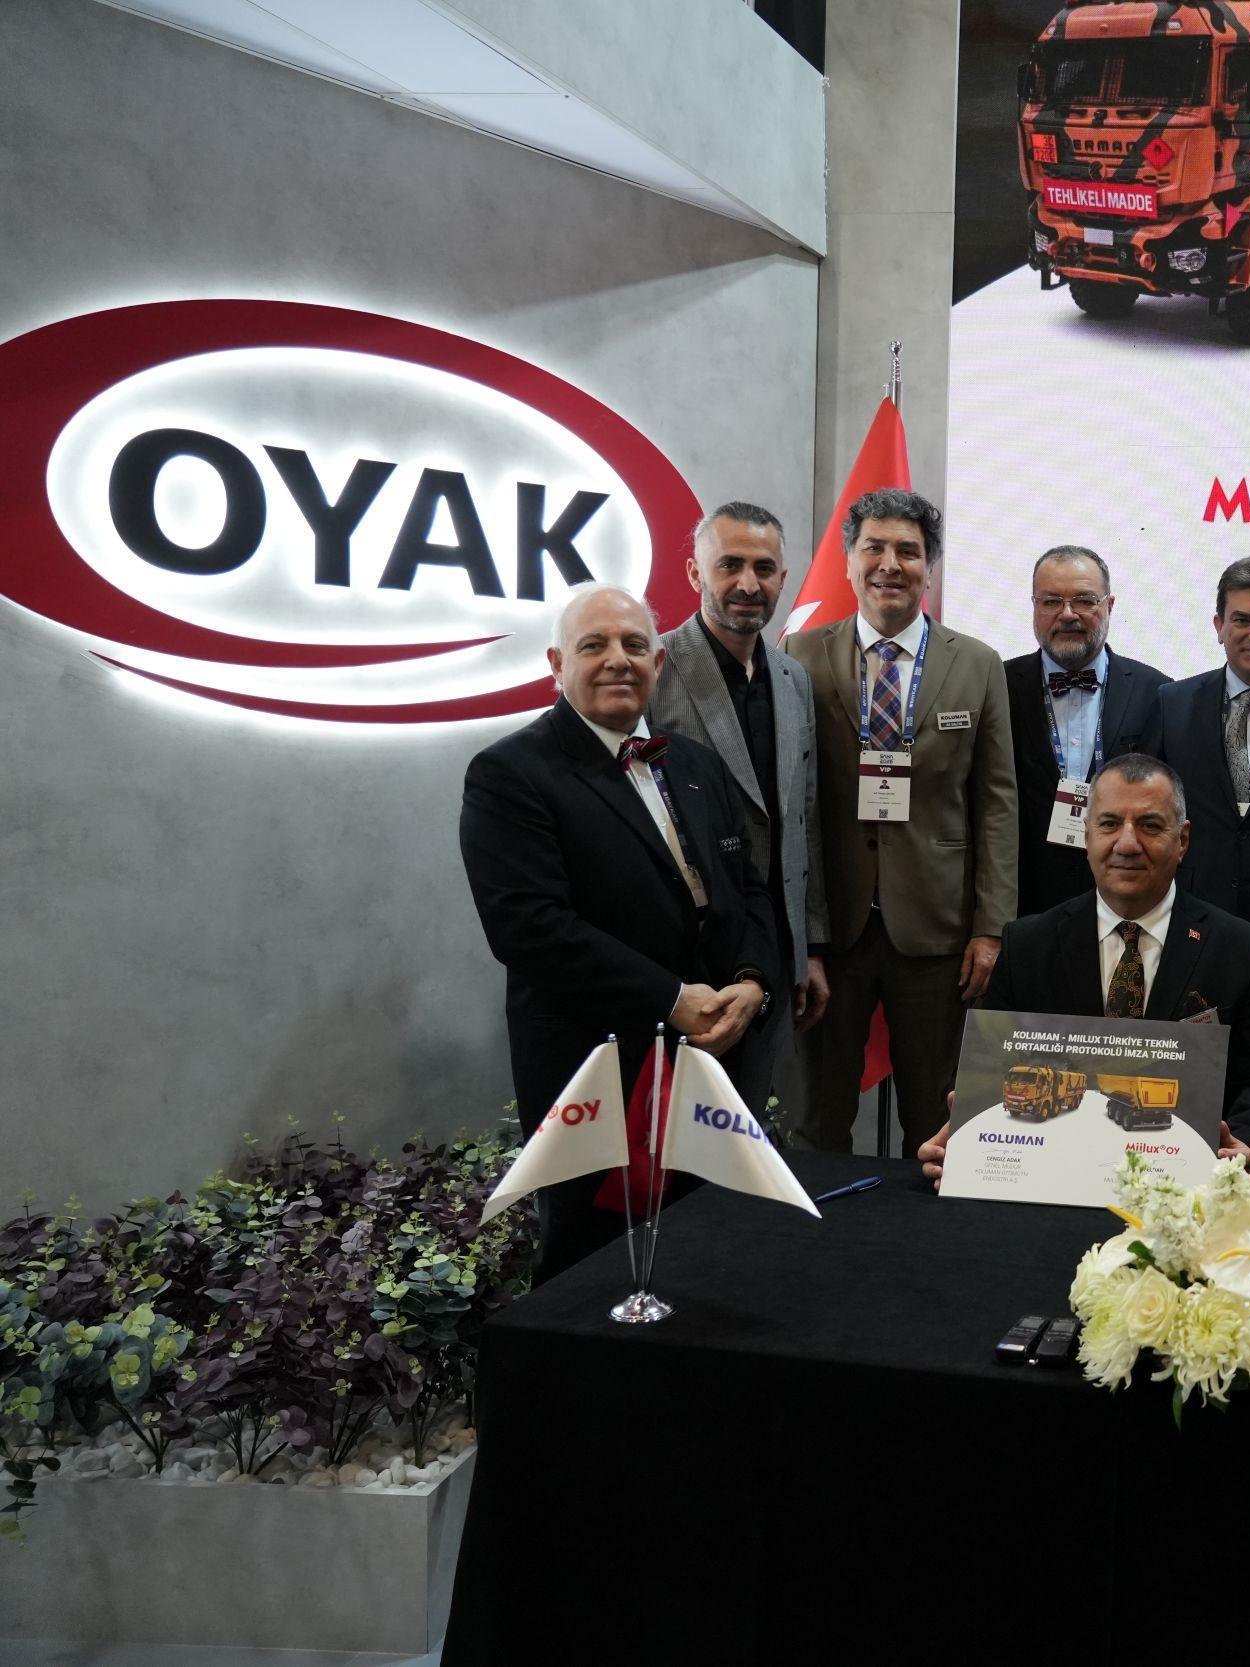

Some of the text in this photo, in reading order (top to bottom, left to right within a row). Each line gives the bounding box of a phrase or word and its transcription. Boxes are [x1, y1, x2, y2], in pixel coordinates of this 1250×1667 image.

[1047, 187, 1153, 212] TEHLİKELİ MADDE
[108, 428, 610, 602] OYAK
[1013, 1030, 1060, 1041] KOLUMAN
[1068, 1034, 1101, 1044] MIILUX
[1103, 1035, 1143, 1047] TÜRKİYE
[1144, 1038, 1179, 1049] TEKNİK
[1003, 1040, 1186, 1061] İŞ ORTAKLIĞI PROTOKOLÜ İMZA TÖRENİ
[978, 1132, 1044, 1146] KOLUMAN
